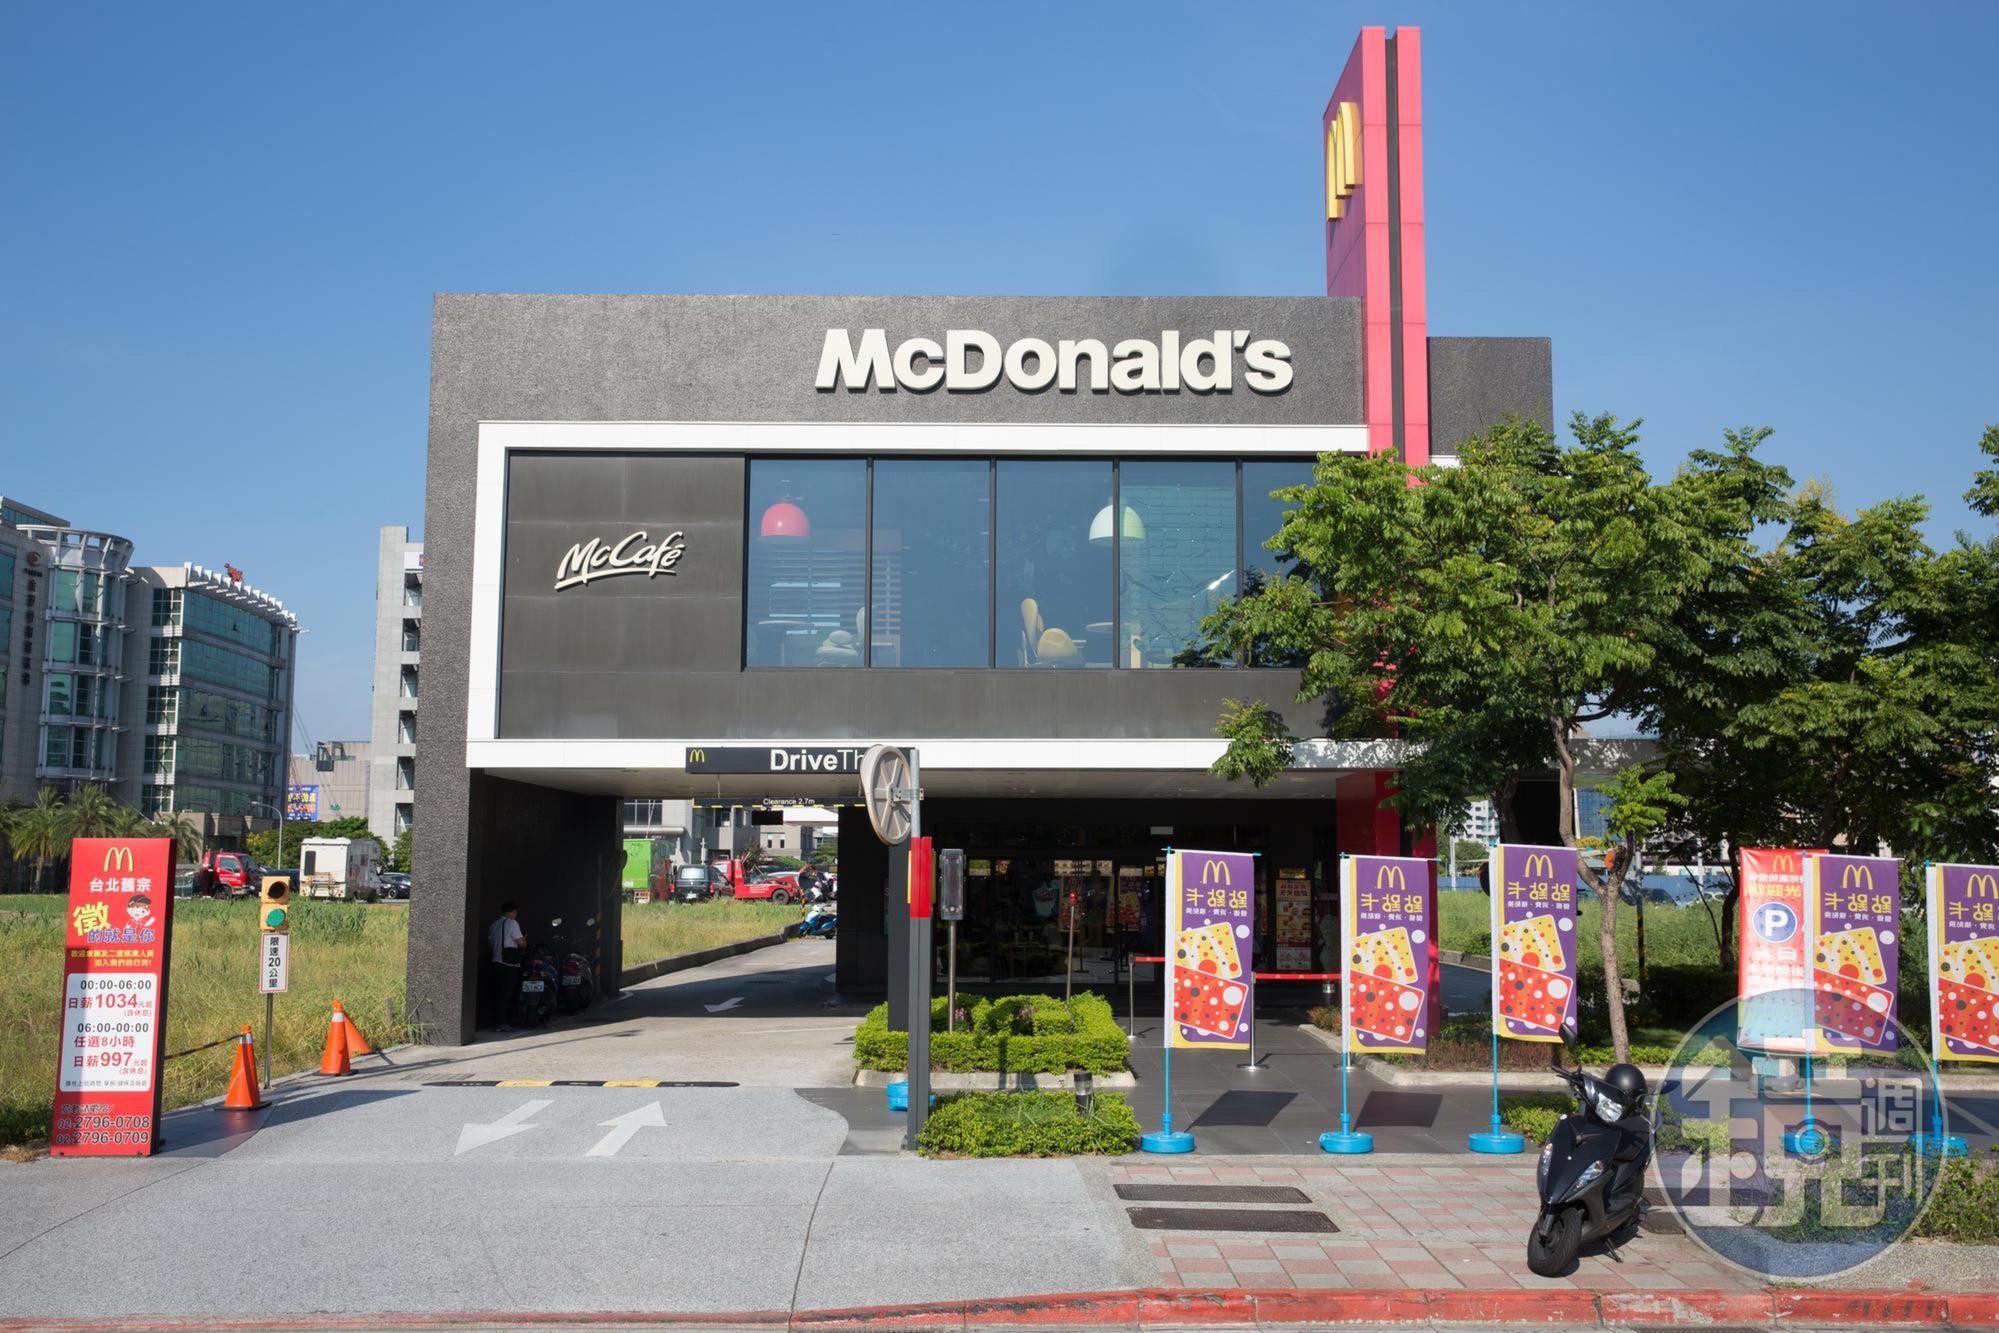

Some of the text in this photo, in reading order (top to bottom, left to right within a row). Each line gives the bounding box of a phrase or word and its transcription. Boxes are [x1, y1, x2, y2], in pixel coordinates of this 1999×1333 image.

[814, 328, 1294, 394] McDonald's
[555, 531, 687, 590] McCafé
[90, 877, 152, 892] 台北舊宗
[72, 901, 154, 944] 徵 的就是你
[268, 937, 281, 988] 限速20公里
[80, 980, 152, 990] 00:00-06:00
[77, 1022, 149, 1033] 06:00-00:00
